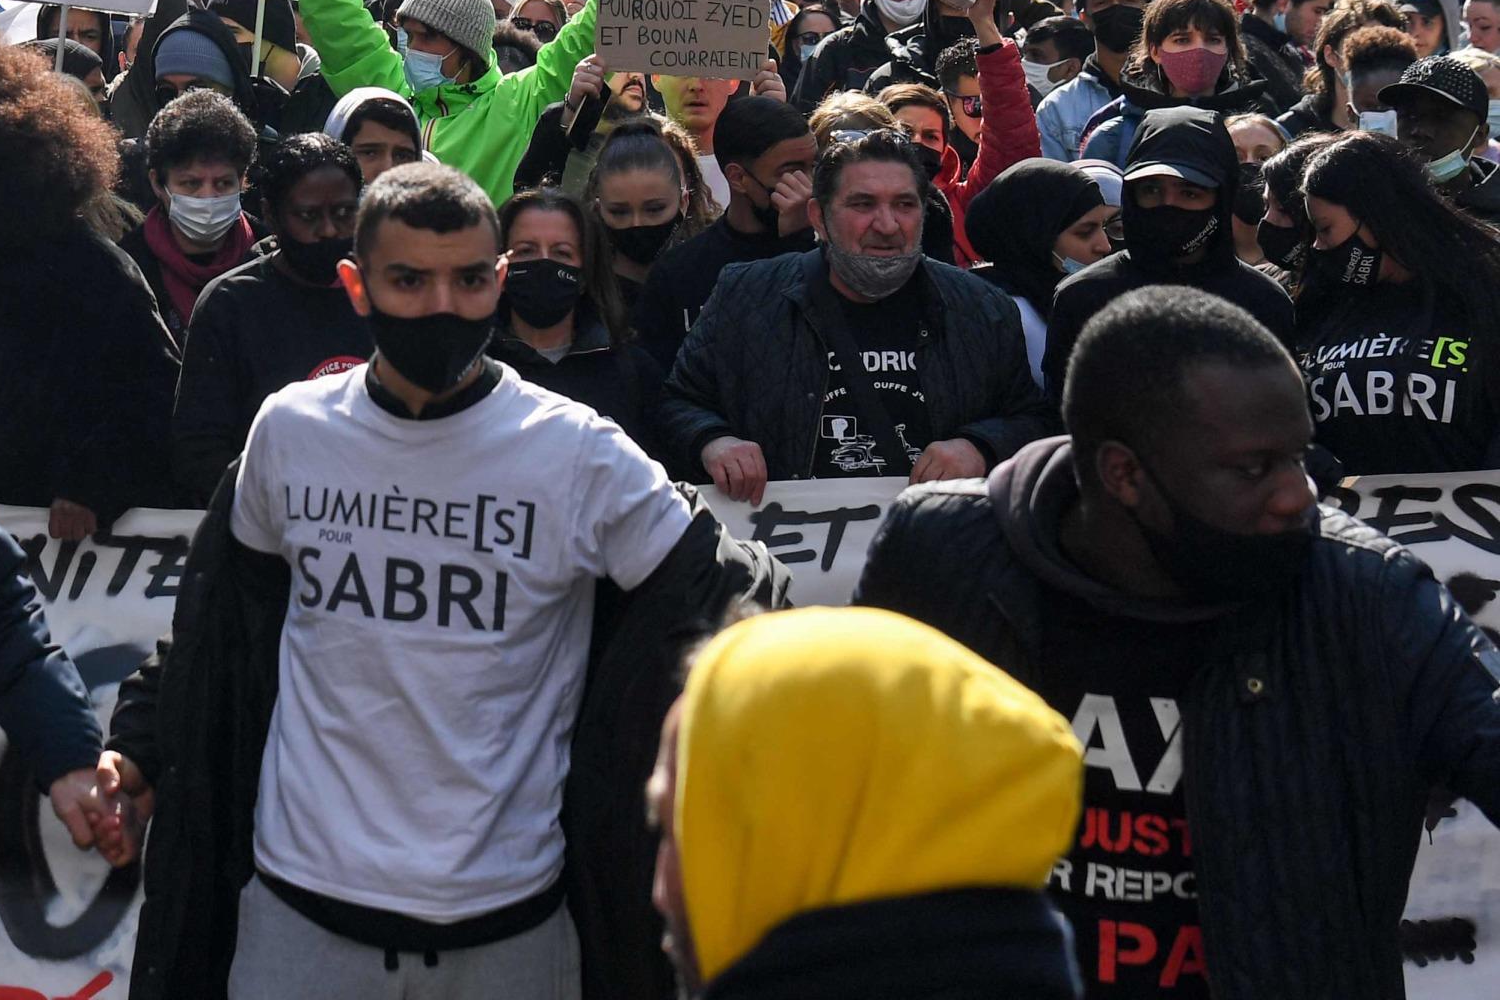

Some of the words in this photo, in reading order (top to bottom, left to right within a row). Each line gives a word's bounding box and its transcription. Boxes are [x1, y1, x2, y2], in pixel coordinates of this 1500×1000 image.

[705, 1, 762, 29] ZYED
[600, 25, 629, 46] ET
[638, 25, 698, 45] BOUNA
[650, 50, 766, 69] COURRAIENT
[1354, 256, 1374, 285] SABRI
[1323, 360, 1346, 371] POUR
[1310, 370, 1457, 424] SABRI
[285, 484, 536, 561] LUMIÈRE[S]
[319, 528, 352, 544] POUR
[749, 501, 882, 573] ET
[297, 547, 509, 632] SABRI
